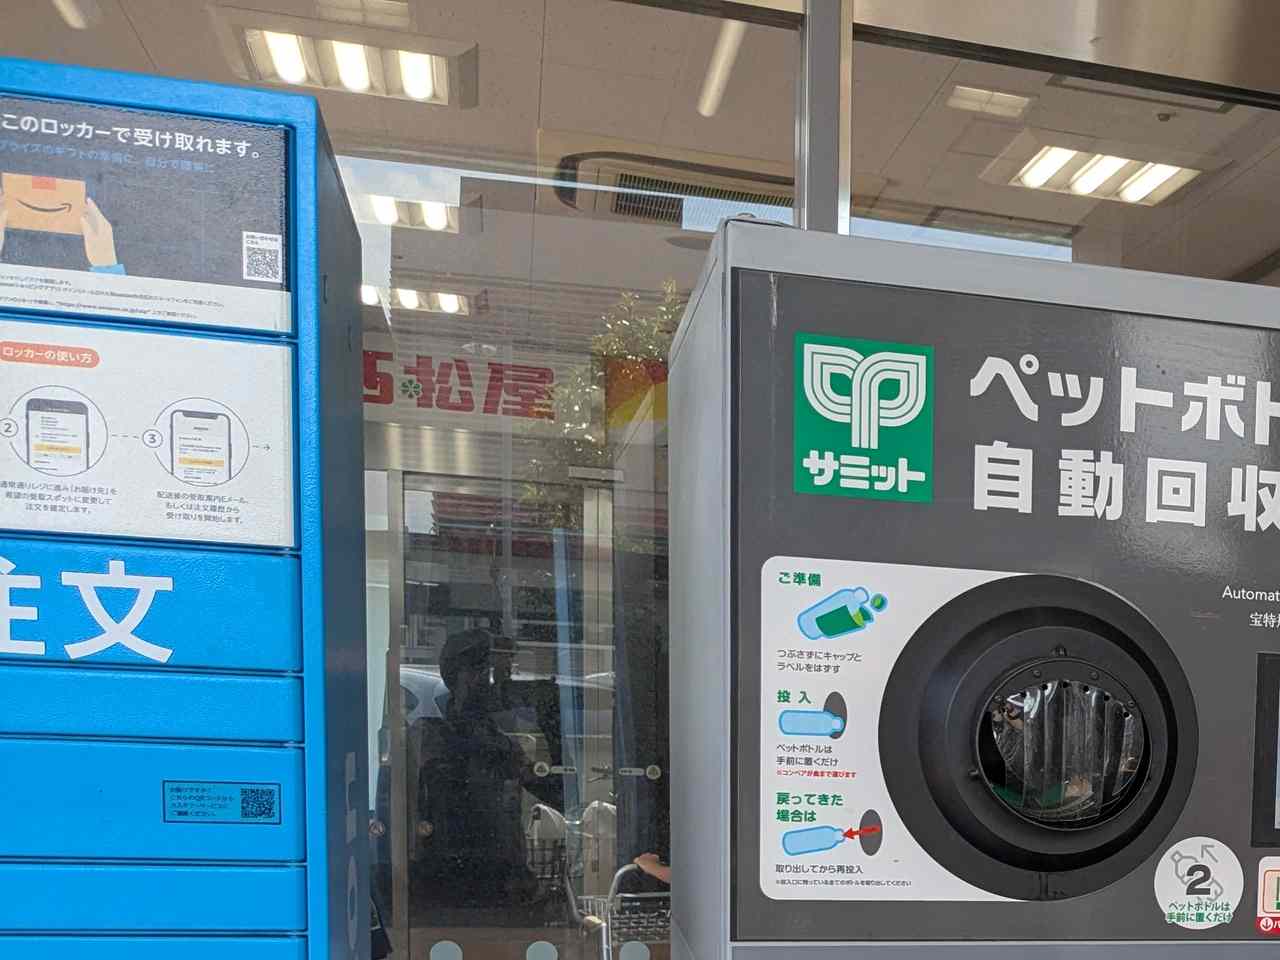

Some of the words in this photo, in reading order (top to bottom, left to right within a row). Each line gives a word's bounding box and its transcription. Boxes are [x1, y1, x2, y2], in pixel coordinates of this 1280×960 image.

[1, 113, 261, 159] このロッカーで受け取れます。
[3, 347, 92, 364] ロッカーの使い方
[4, 423, 12, 433] 2
[149, 434, 156, 444] 3
[802, 450, 926, 493] サミット
[778, 571, 821, 587] ご準備
[777, 649, 863, 662] つぶさずにキャップと
[777, 662, 841, 674] ラベルをはずす
[776, 744, 833, 754] ペットボトルは
[776, 756, 838, 767] 手前に置くだけ
[776, 792, 844, 806] 戻ってきた
[776, 809, 817, 823] 場合は
[775, 864, 864, 874] 取り出してから再投入
[1185, 864, 1211, 896] 2
[1168, 901, 1231, 912] ペットボトルは
[1166, 911, 1232, 923] 手前に置くだけ
